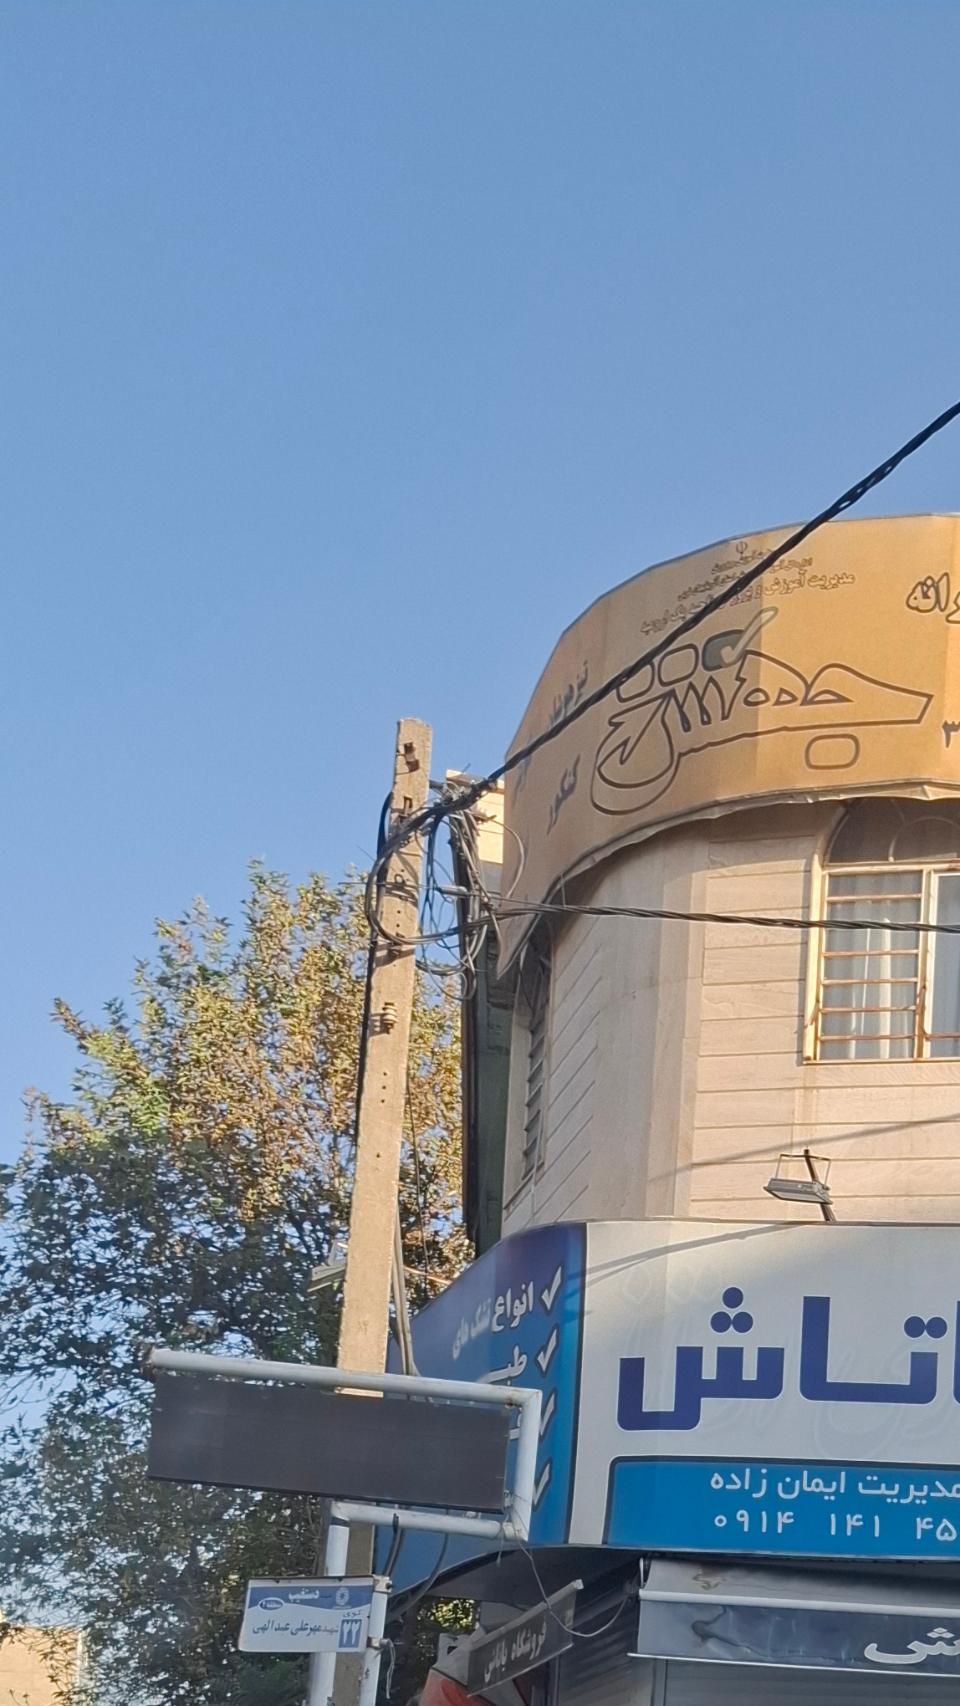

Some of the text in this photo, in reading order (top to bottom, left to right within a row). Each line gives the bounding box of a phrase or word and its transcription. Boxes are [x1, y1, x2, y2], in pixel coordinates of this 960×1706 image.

[491, 1280, 534, 1333] انواع
[710, 1468, 768, 1499] زاده
[777, 1470, 846, 1500] ایمان
[714, 1509, 795, 1534] ۰۹۱۴
[830, 1513, 880, 1538] ۱۴۱
